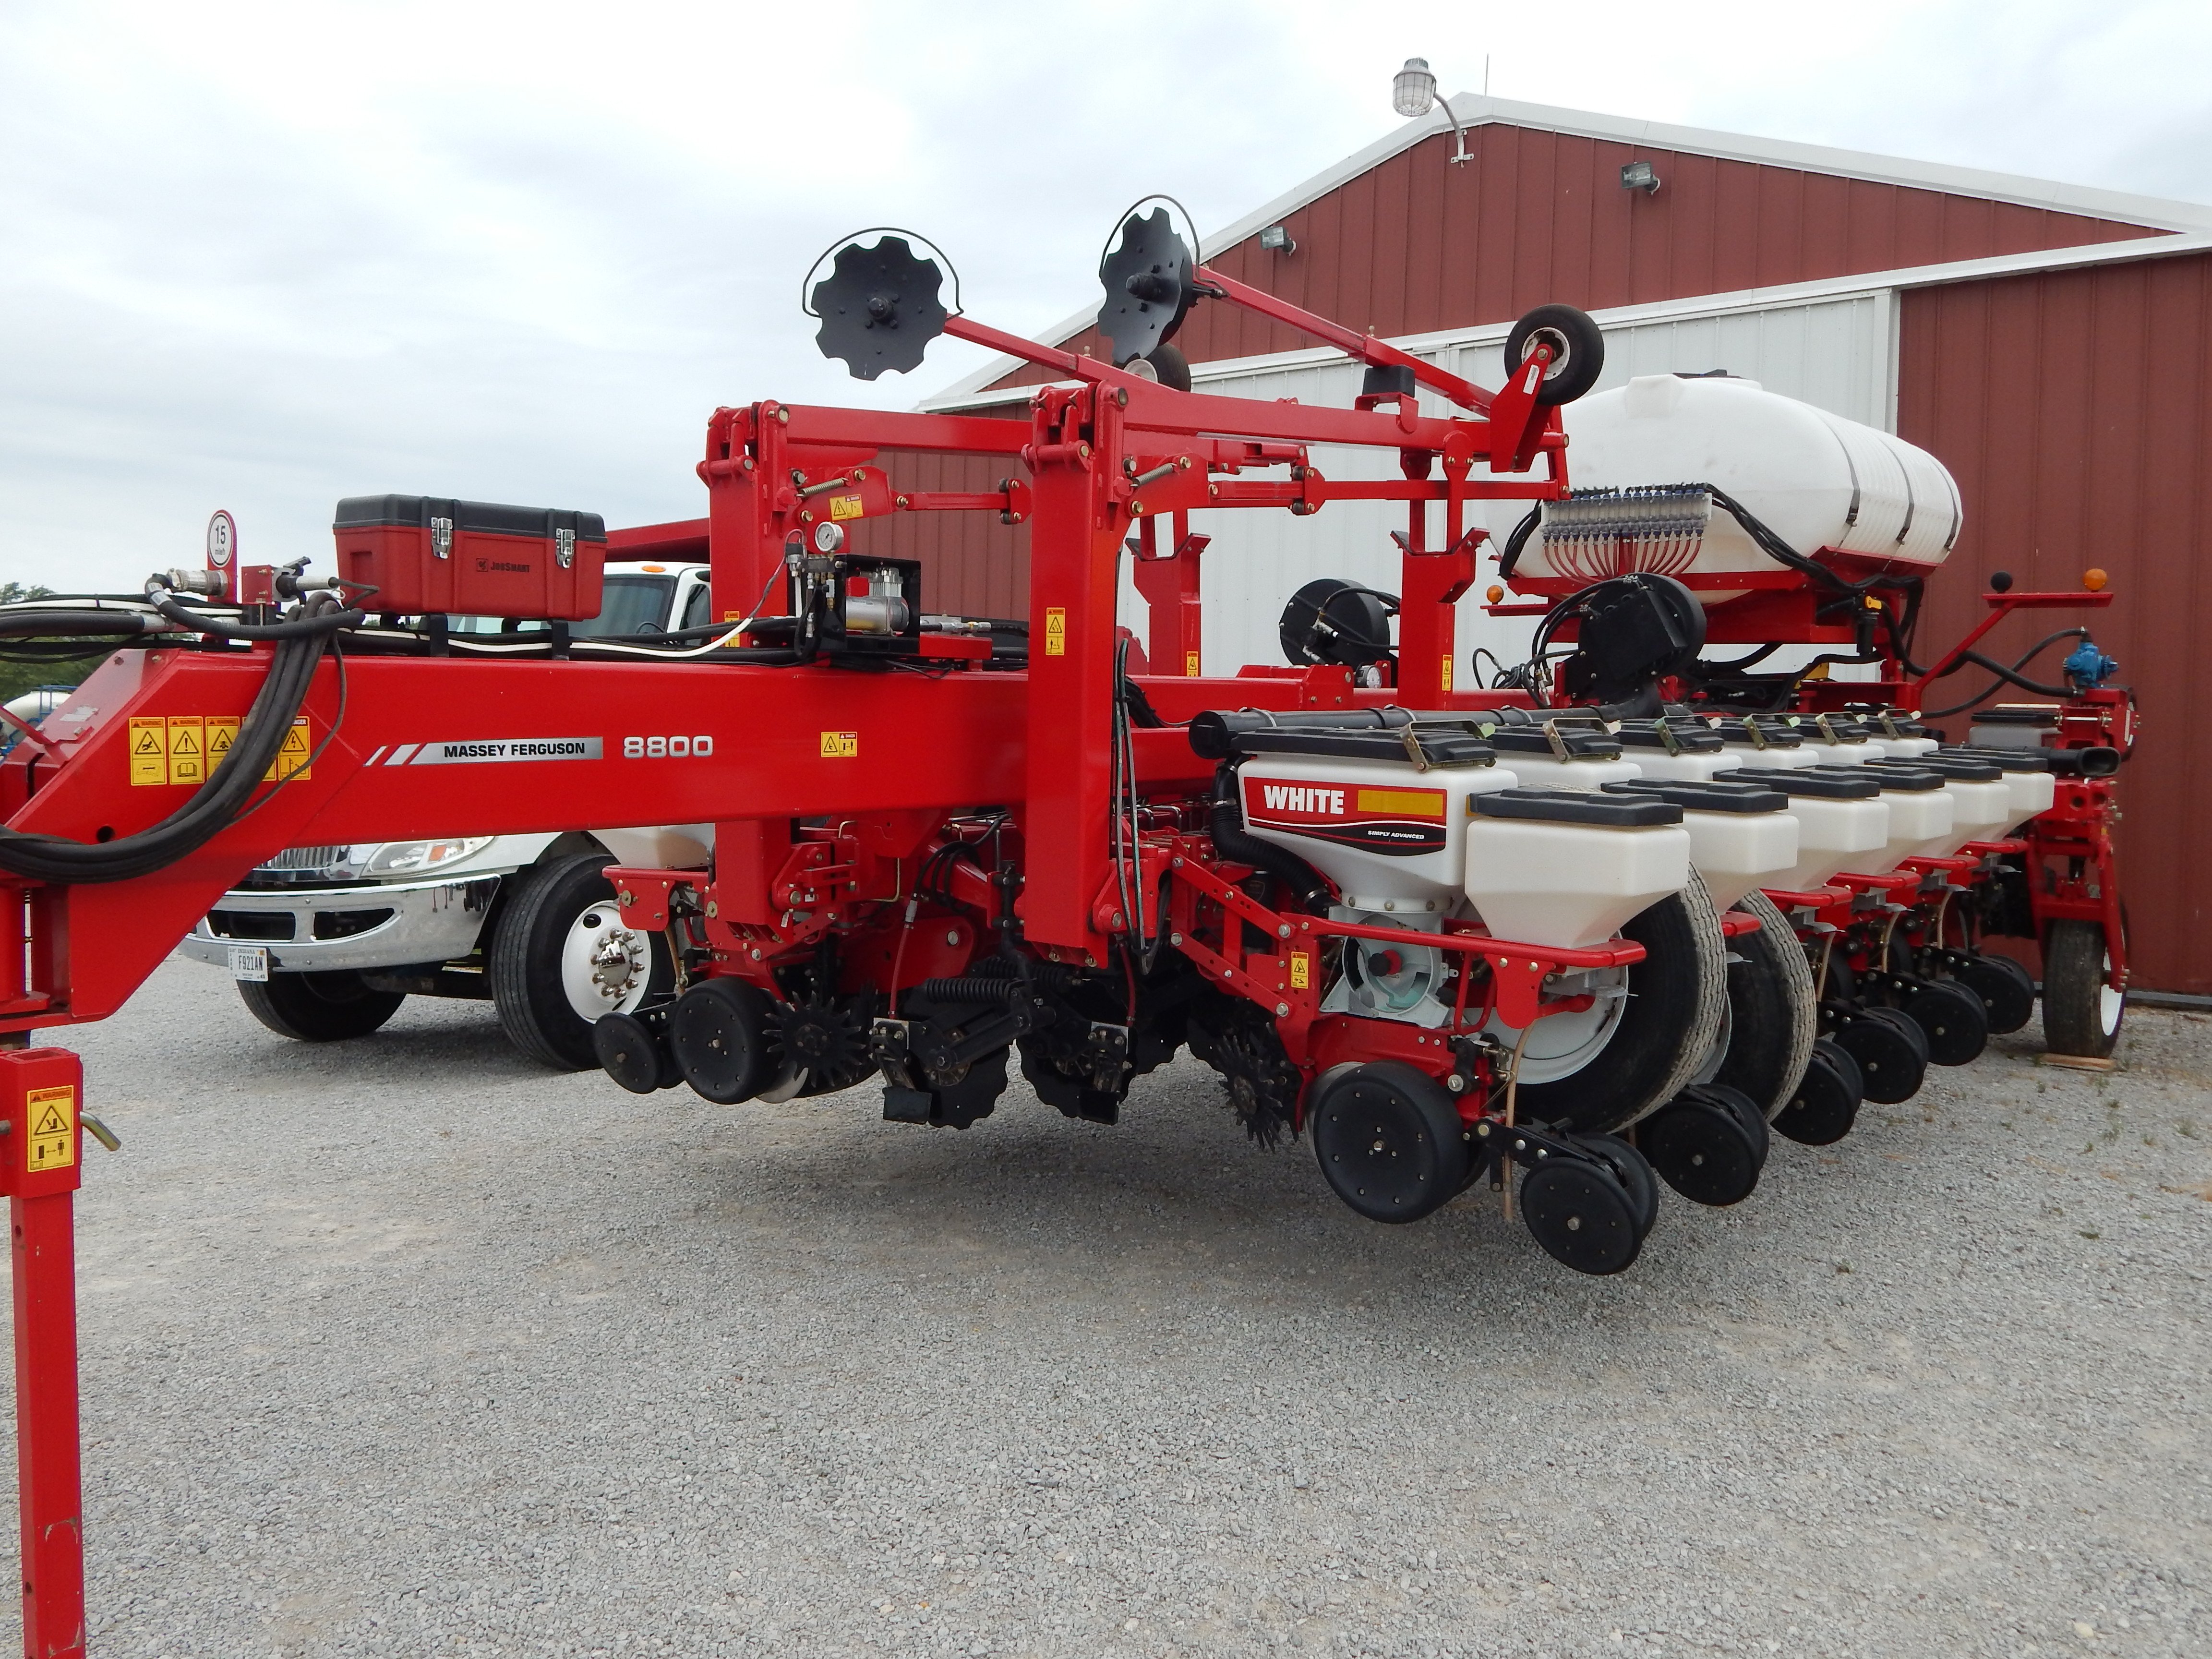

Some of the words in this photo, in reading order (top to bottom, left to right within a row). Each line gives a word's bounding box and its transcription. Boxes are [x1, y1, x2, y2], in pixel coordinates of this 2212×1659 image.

[215, 525, 226, 544] 15
[444, 745, 506, 758] MASSEY
[511, 742, 585, 756] FERGUSON
[624, 735, 714, 758] 8800
[1263, 785, 1344, 815] WHITE
[239, 955, 263, 971] F921AN
[43, 1089, 70, 1099] WARNING
